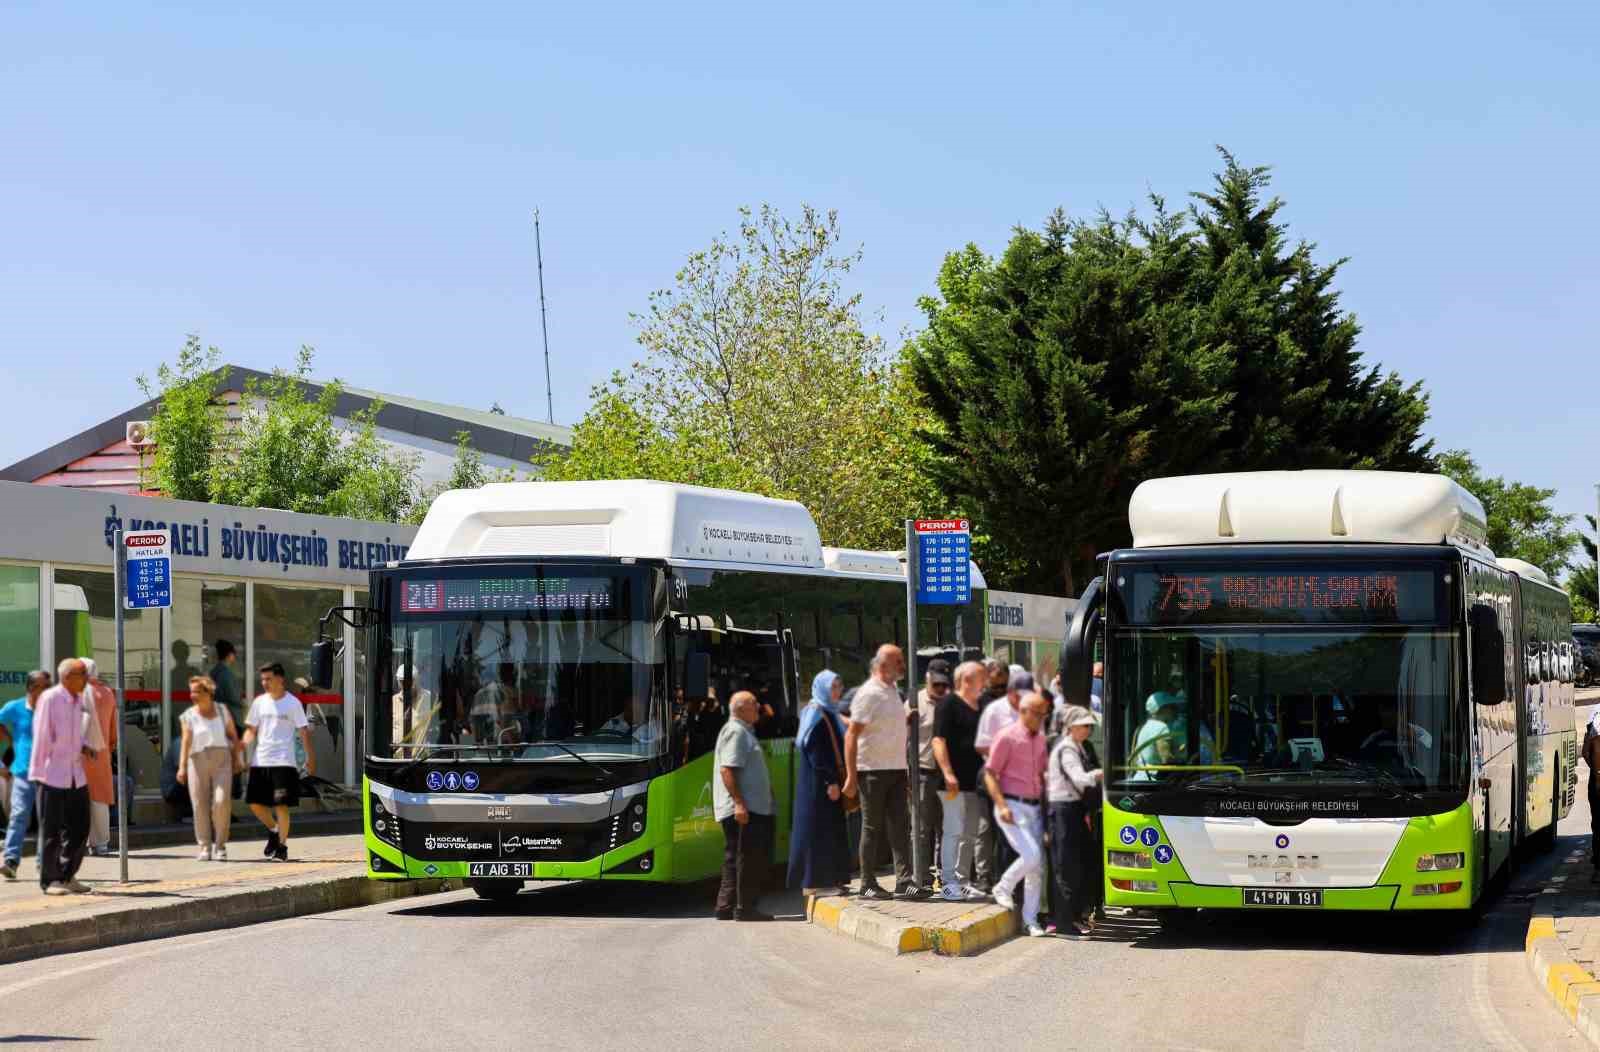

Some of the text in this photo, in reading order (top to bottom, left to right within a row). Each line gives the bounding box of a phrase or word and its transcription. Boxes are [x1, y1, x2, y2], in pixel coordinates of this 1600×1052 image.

[136, 548, 164, 557] HATLAR
[221, 522, 328, 571] BÜYÜKŞEHİR
[676, 578, 688, 599] 511
[1159, 577, 1212, 609] 755
[1312, 799, 1359, 810] BELEDİYESİ
[472, 864, 529, 875] 41 AIG 511
[1254, 891, 1317, 904] 41 PN 191
